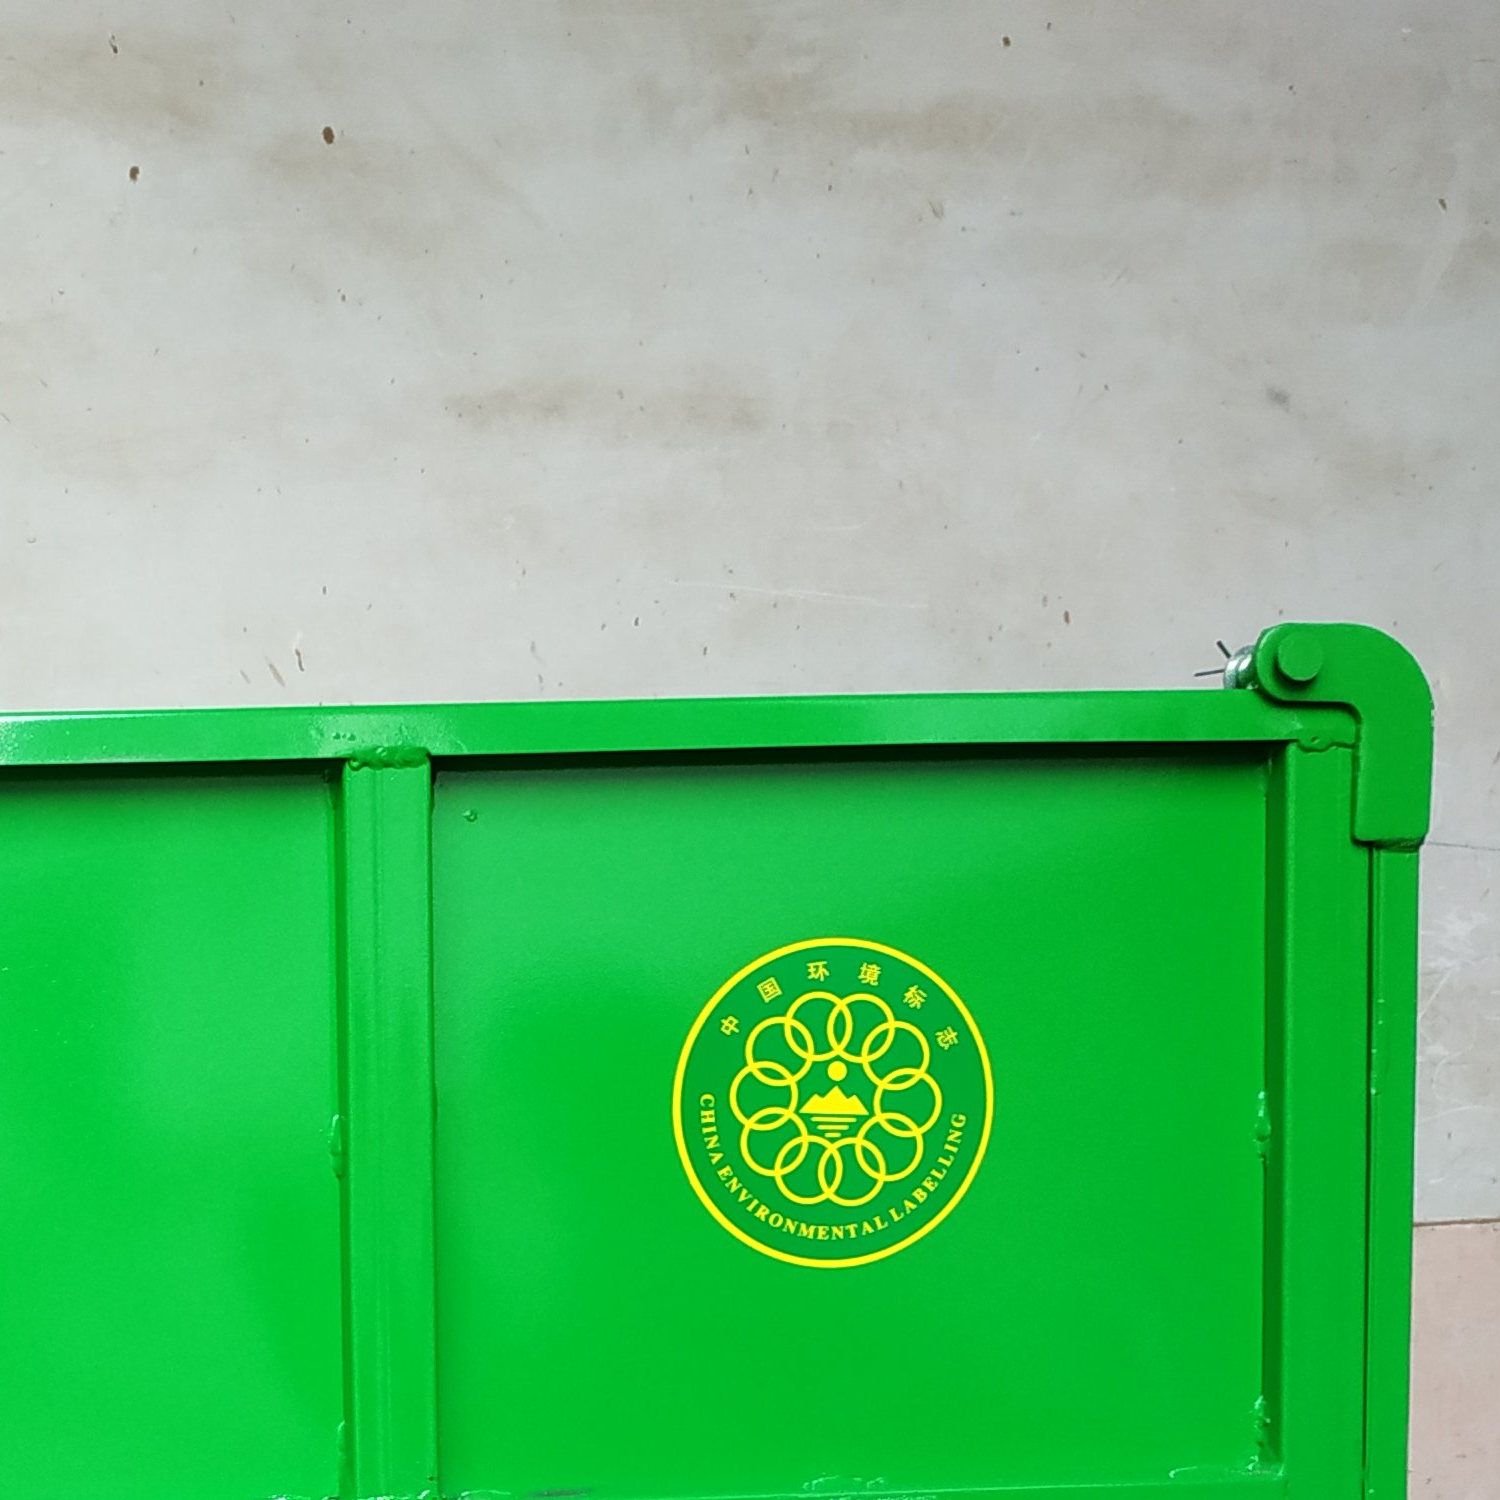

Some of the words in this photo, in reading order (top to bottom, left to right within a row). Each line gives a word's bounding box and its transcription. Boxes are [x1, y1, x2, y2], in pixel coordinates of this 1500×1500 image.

[720, 960, 959, 1050] 中国环境标志
[700, 1093, 725, 1166] CHINA
[717, 1165, 889, 1240] ENVIRONMENTAL
[888, 1113, 967, 1223] LABELLING
